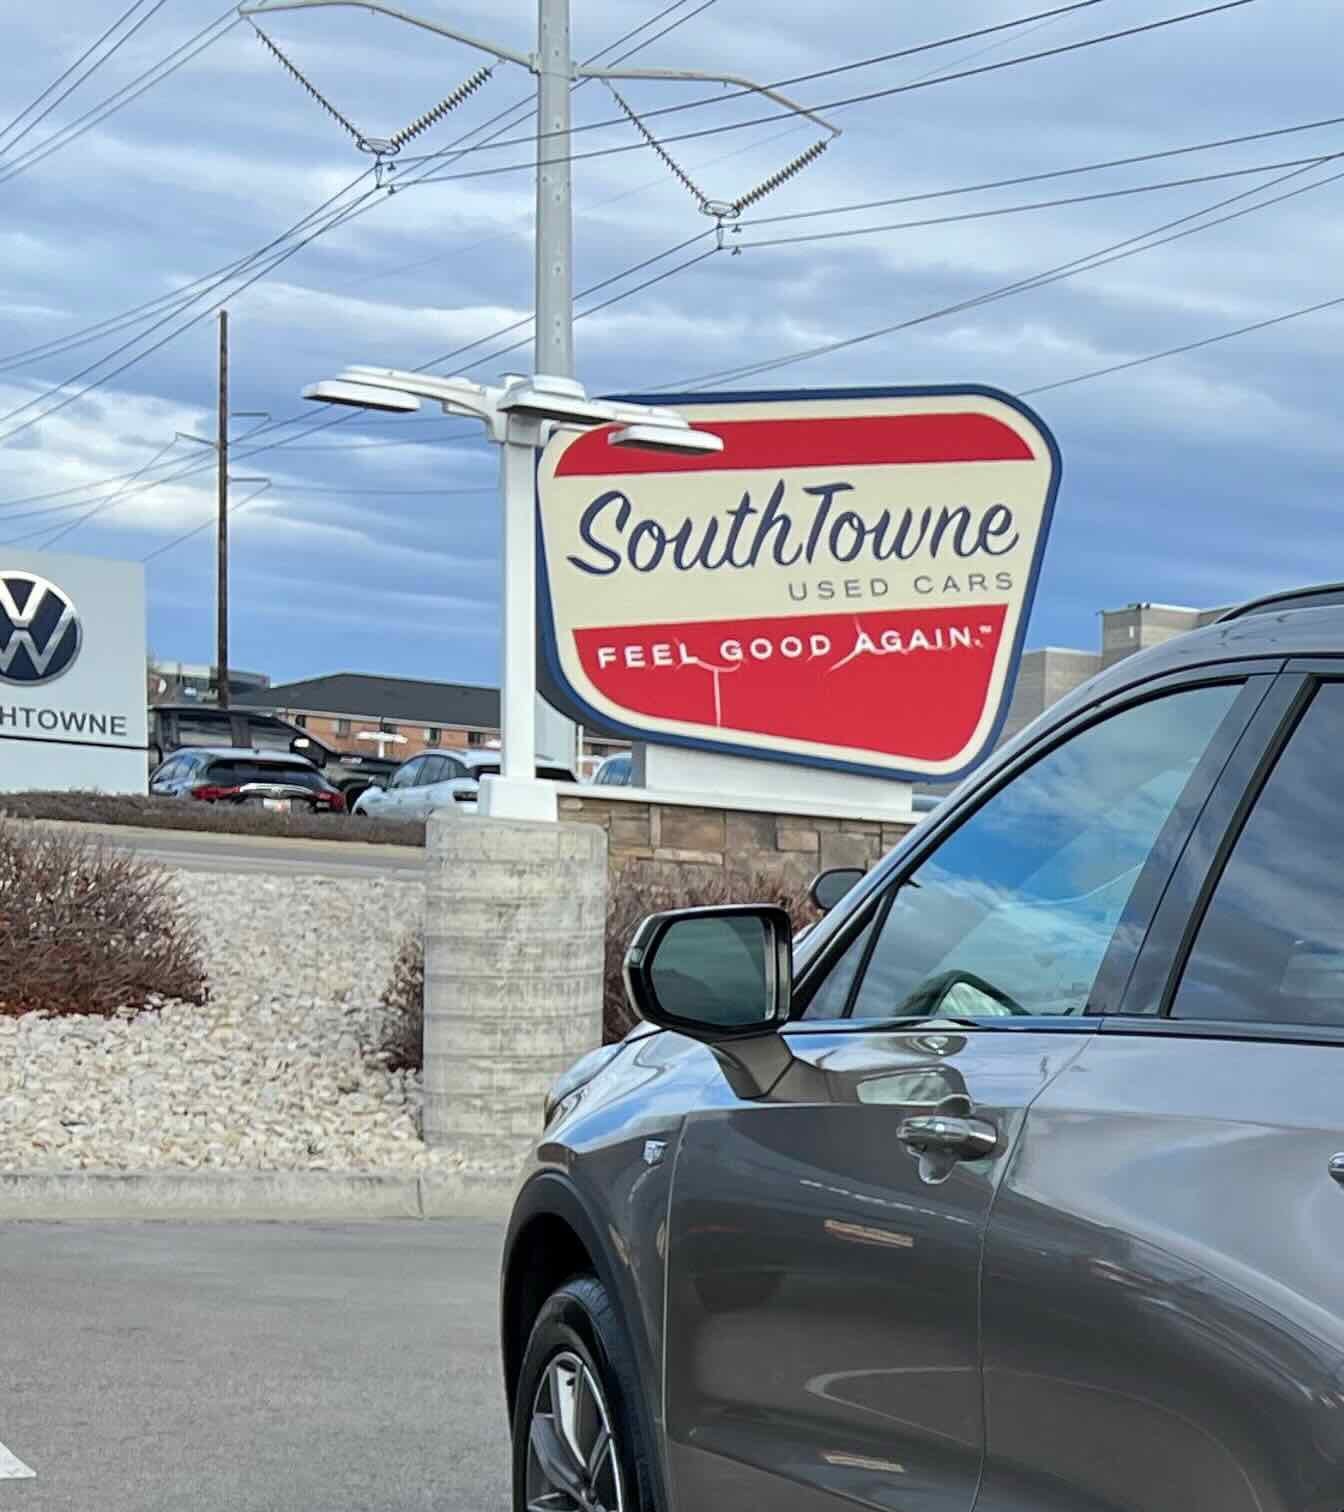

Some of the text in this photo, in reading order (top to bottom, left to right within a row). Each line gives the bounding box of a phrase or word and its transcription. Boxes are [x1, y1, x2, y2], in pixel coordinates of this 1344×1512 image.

[566, 479, 1020, 575] SouthTowne
[788, 571, 1014, 602] USED CARS
[598, 642, 698, 669] FEEL
[720, 633, 832, 661] GOOD
